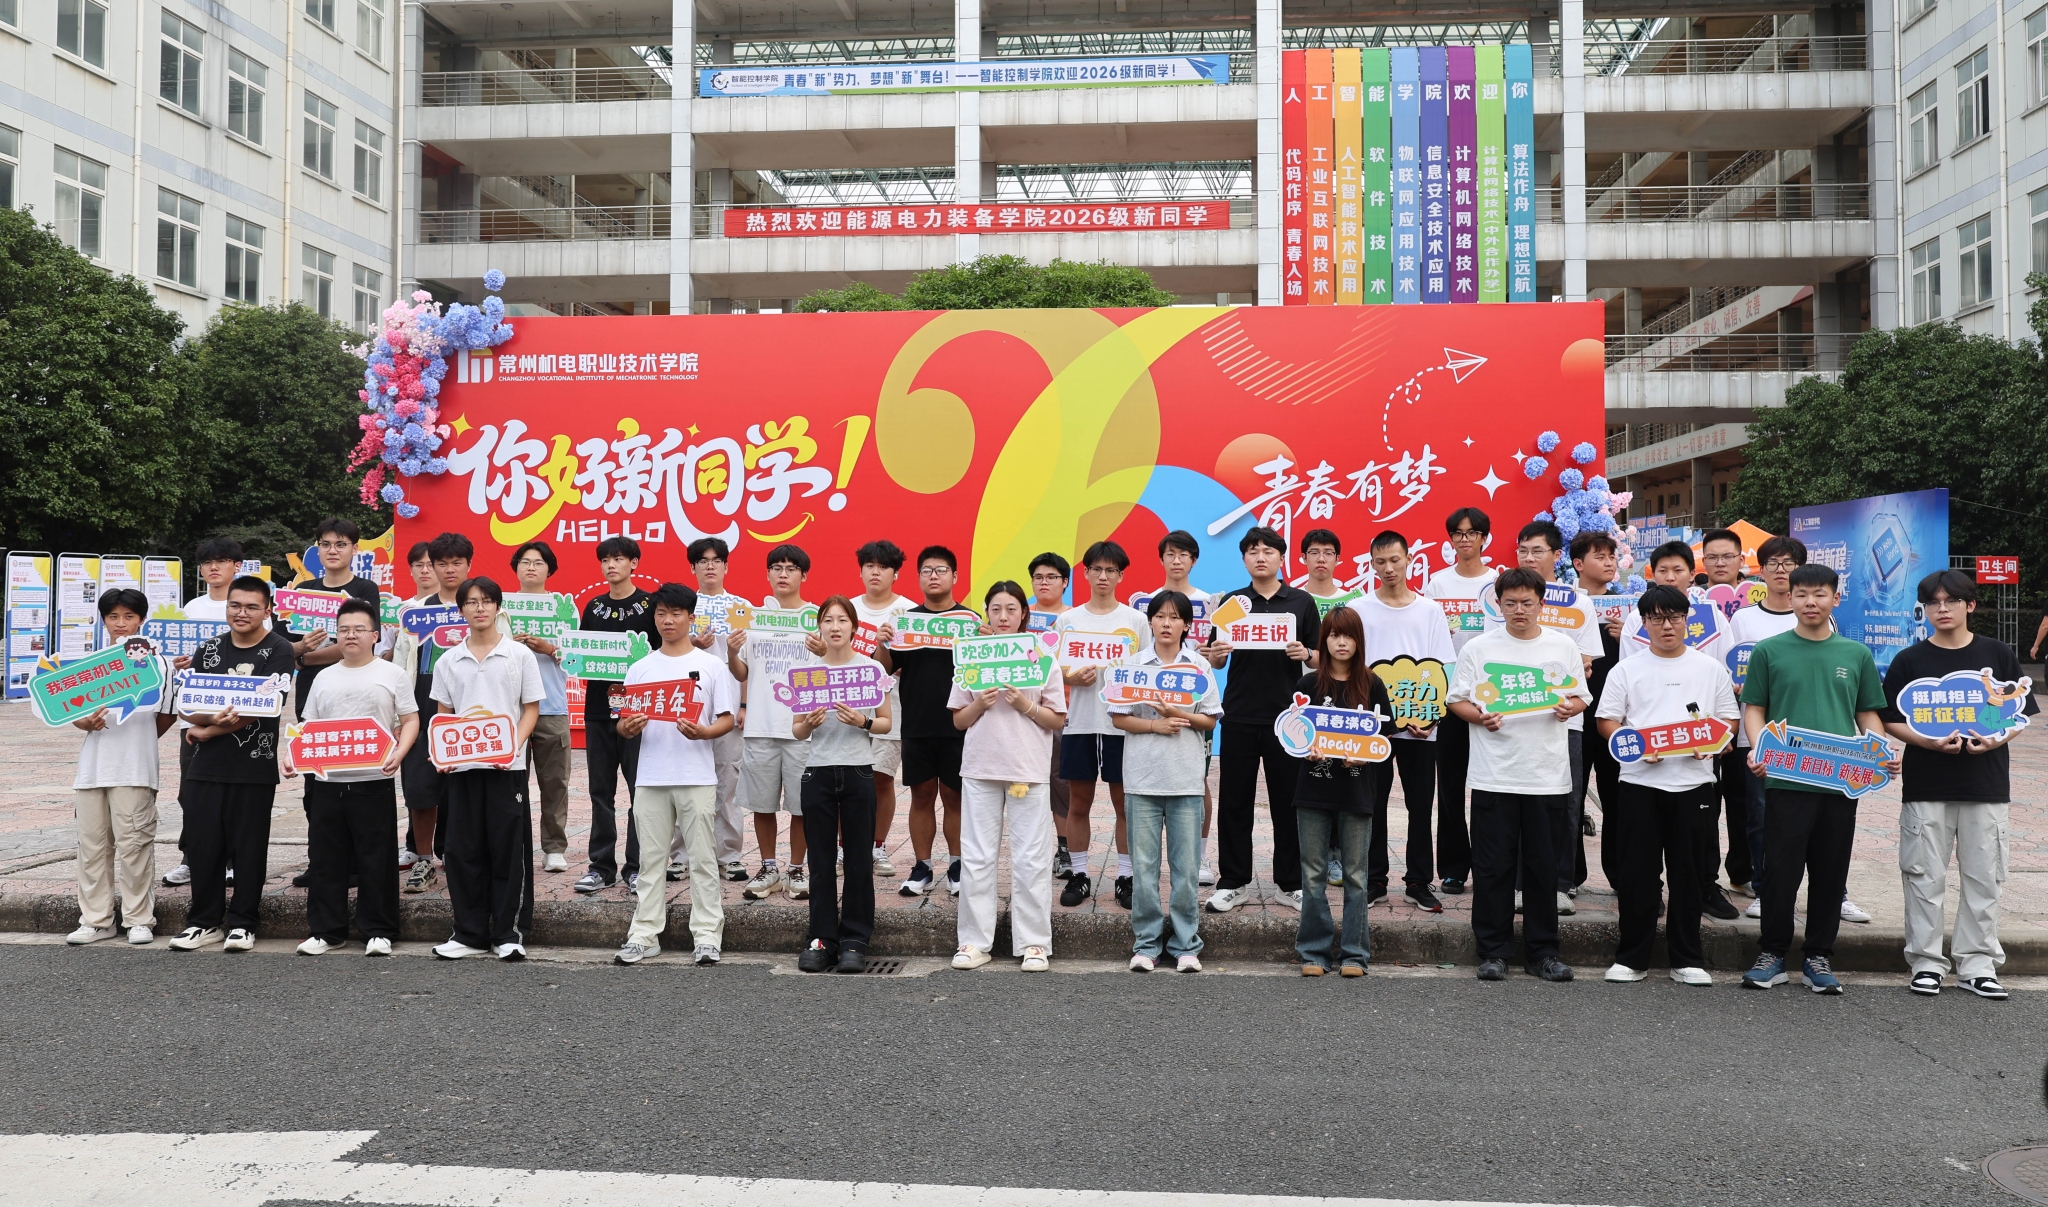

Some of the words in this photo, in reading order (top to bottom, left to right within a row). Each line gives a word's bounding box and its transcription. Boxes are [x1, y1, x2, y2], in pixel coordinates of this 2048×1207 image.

[731, 74, 779, 83] 智能控制学院
[1285, 148, 1302, 216] 代码作序
[1512, 143, 1530, 212] 算法作舟
[746, 205, 1208, 233] 热烈欢迎能源电力装备学院2026级新同学
[1312, 147, 1329, 294] 工业互联网技术
[1341, 146, 1357, 294] 人工智能技术应用
[1369, 147, 1386, 294] 软件技术
[1398, 145, 1415, 293] 物联网应用技术
[1426, 145, 1444, 293] 信息安全技术应用
[1455, 145, 1472, 293] 计算机网络技术
[1286, 228, 1302, 296] 青春入场
[1514, 225, 1531, 293] 理想远航
[498, 353, 699, 374] 常州机电职业技术学院
[556, 519, 667, 544] HELLO
[1978, 559, 2018, 574] 卫生间
[282, 594, 342, 614] 心向阳光
[408, 611, 467, 626] 小小新学
[756, 614, 799, 628] 机电初遇
[897, 617, 926, 631] 青春
[931, 620, 976, 638] 心向党
[562, 637, 628, 651] 让青春在新时代
[1231, 624, 1289, 643] 新生说
[962, 639, 1025, 661] 欢迎加入
[1068, 641, 1124, 660] 家长说
[45, 658, 126, 696] 我爱常机电
[792, 667, 875, 689] 青春正开场
[981, 665, 1043, 685] 青春主场
[1114, 668, 1148, 686] 新的
[1162, 673, 1197, 691] 故事
[1500, 671, 1536, 690] 年轻
[86, 673, 141, 703] CZIMT
[799, 685, 877, 706] 梦想正起航
[1132, 688, 1183, 703] 从这里开始
[1912, 689, 1984, 704] 挺膺担当
[182, 694, 226, 706] 乘风破浪
[231, 696, 275, 708] 扬帆起航
[1392, 699, 1441, 721] 未来
[1316, 713, 1374, 732] 青春满电
[1913, 706, 1977, 724] 新征程
[301, 728, 378, 744] 希望寄予青年
[443, 724, 499, 743] 青年强
[1616, 734, 1638, 747] 乘风
[1650, 722, 1712, 749] 正当时
[301, 743, 379, 759] 未来属于青年
[445, 740, 503, 757] 则国家强
[1319, 736, 1361, 754] Ready
[1370, 741, 1387, 754] Go
[1618, 746, 1640, 758] 破浪
[1763, 748, 1797, 770] 新学期
[1800, 755, 1835, 777] 新目标
[1838, 763, 1875, 785] 新发展
